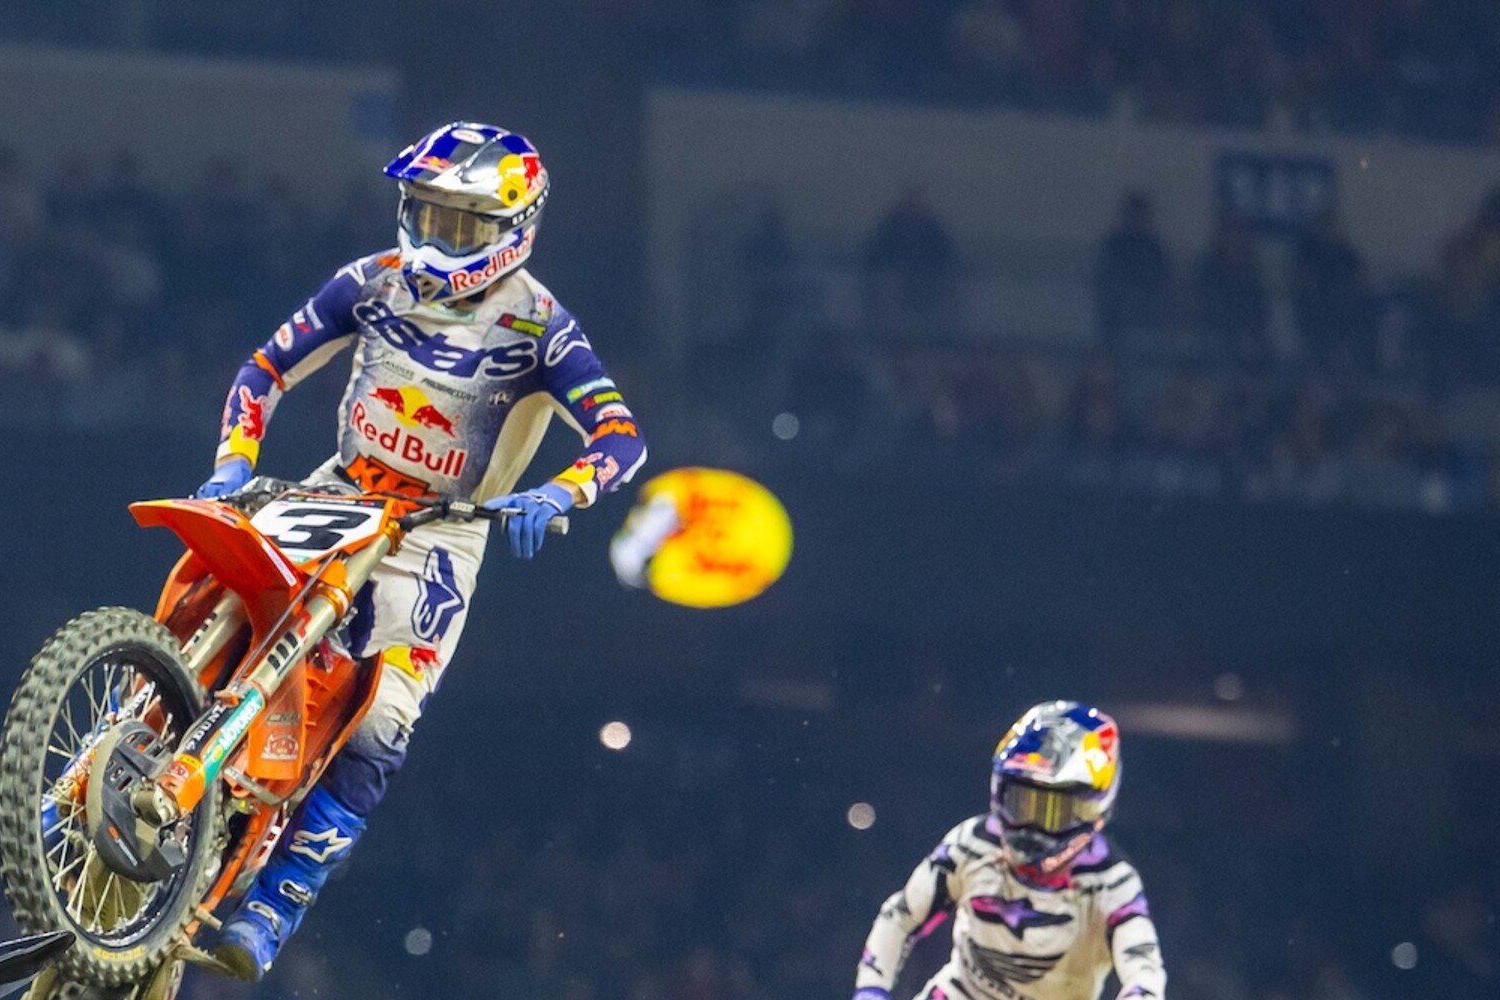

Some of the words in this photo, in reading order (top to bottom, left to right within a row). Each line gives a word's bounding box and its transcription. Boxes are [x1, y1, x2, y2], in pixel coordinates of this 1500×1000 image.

[450, 252, 500, 293] Red
[350, 401, 402, 454] Red
[401, 434, 466, 479] Bull
[266, 507, 373, 550] 3
[216, 701, 263, 751] MOTOREX
